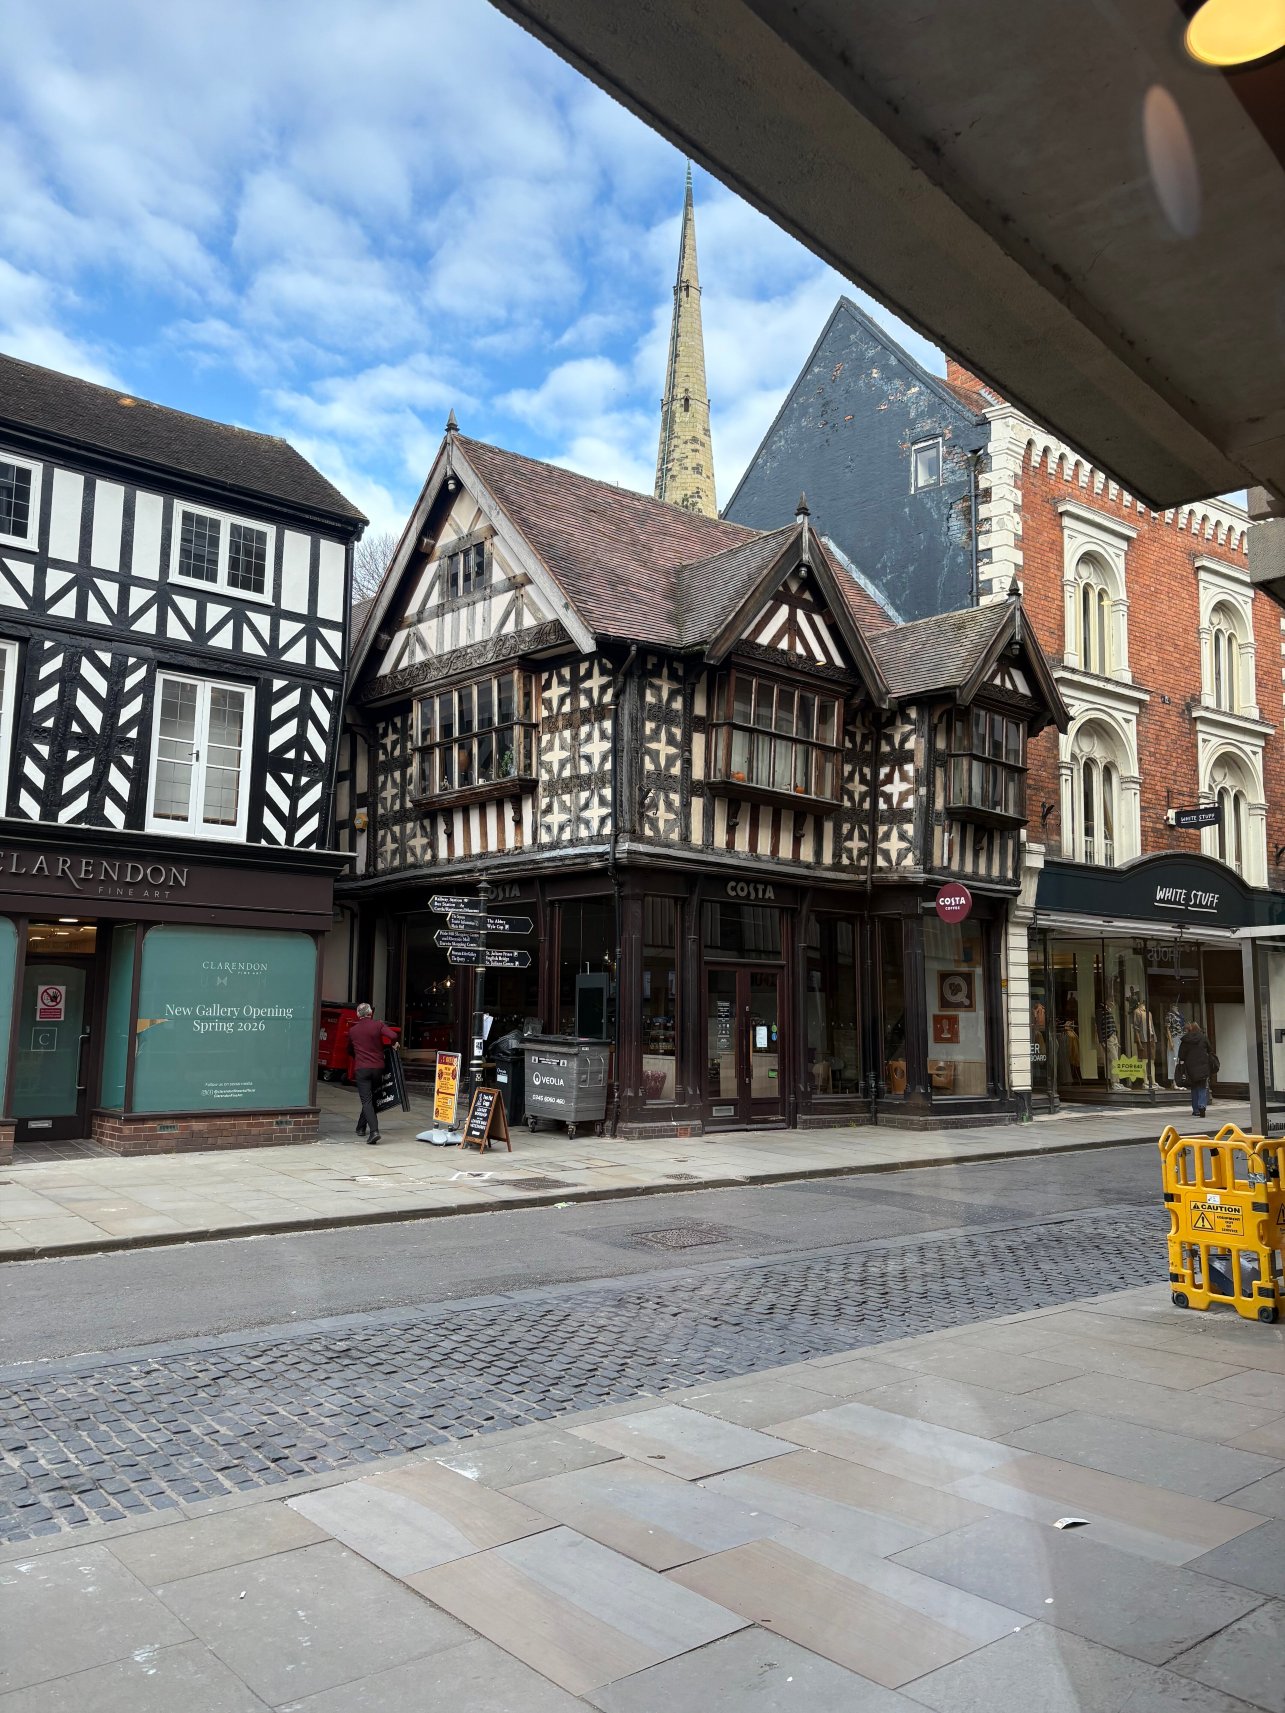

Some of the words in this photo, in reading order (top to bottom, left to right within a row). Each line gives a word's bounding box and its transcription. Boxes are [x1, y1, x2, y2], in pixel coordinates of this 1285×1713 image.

[0, 851, 189, 890] LARENDON
[99, 886, 134, 896] FINE
[143, 889, 171, 899] ART
[488, 884, 521, 901] OSTA
[727, 881, 775, 900] COSTA
[1155, 885, 1187, 904] WHITE
[1189, 890, 1220, 907] STUFF
[939, 896, 966, 906] COSTA
[202, 960, 268, 974] CLARENDON
[165, 1003, 193, 1016] New
[196, 1003, 240, 1019] Gallery
[243, 1004, 294, 1019] Opening
[192, 1020, 235, 1034] Spring
[237, 1020, 266, 1032] 2026
[541, 1076, 565, 1087] VEOLIA
[1201, 1203, 1241, 1214] CAUTION
